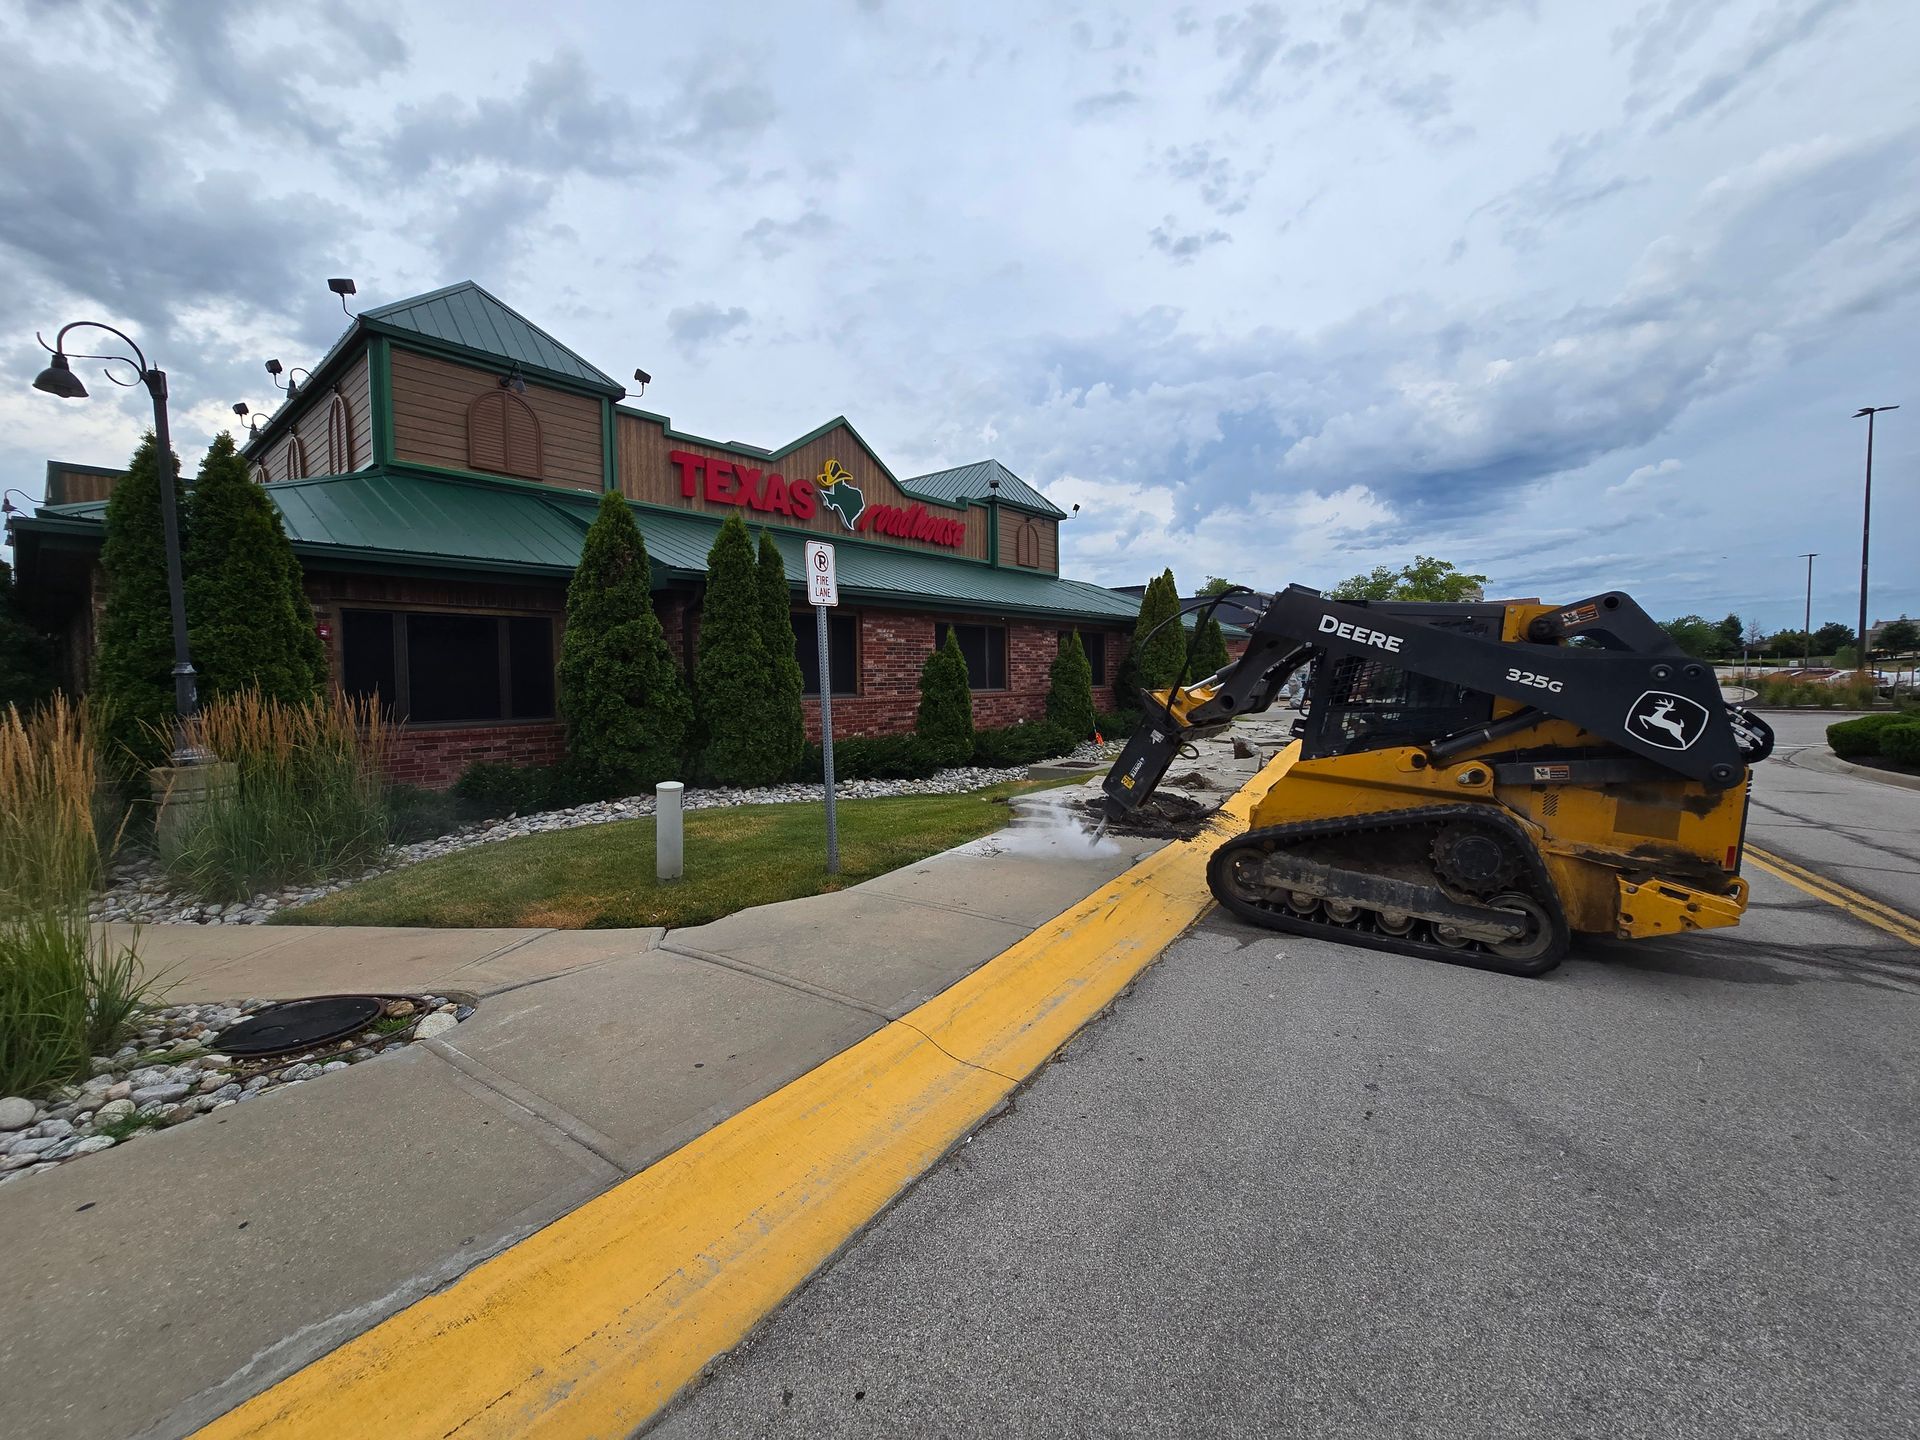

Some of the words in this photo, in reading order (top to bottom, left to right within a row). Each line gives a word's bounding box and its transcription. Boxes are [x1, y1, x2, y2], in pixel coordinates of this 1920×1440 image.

[671, 450, 817, 520] TEXAS
[815, 575, 830, 586] FIRE
[815, 587, 832, 598] LANE
[1318, 614, 1404, 653] DEERE
[1505, 668, 1564, 693] 325G
